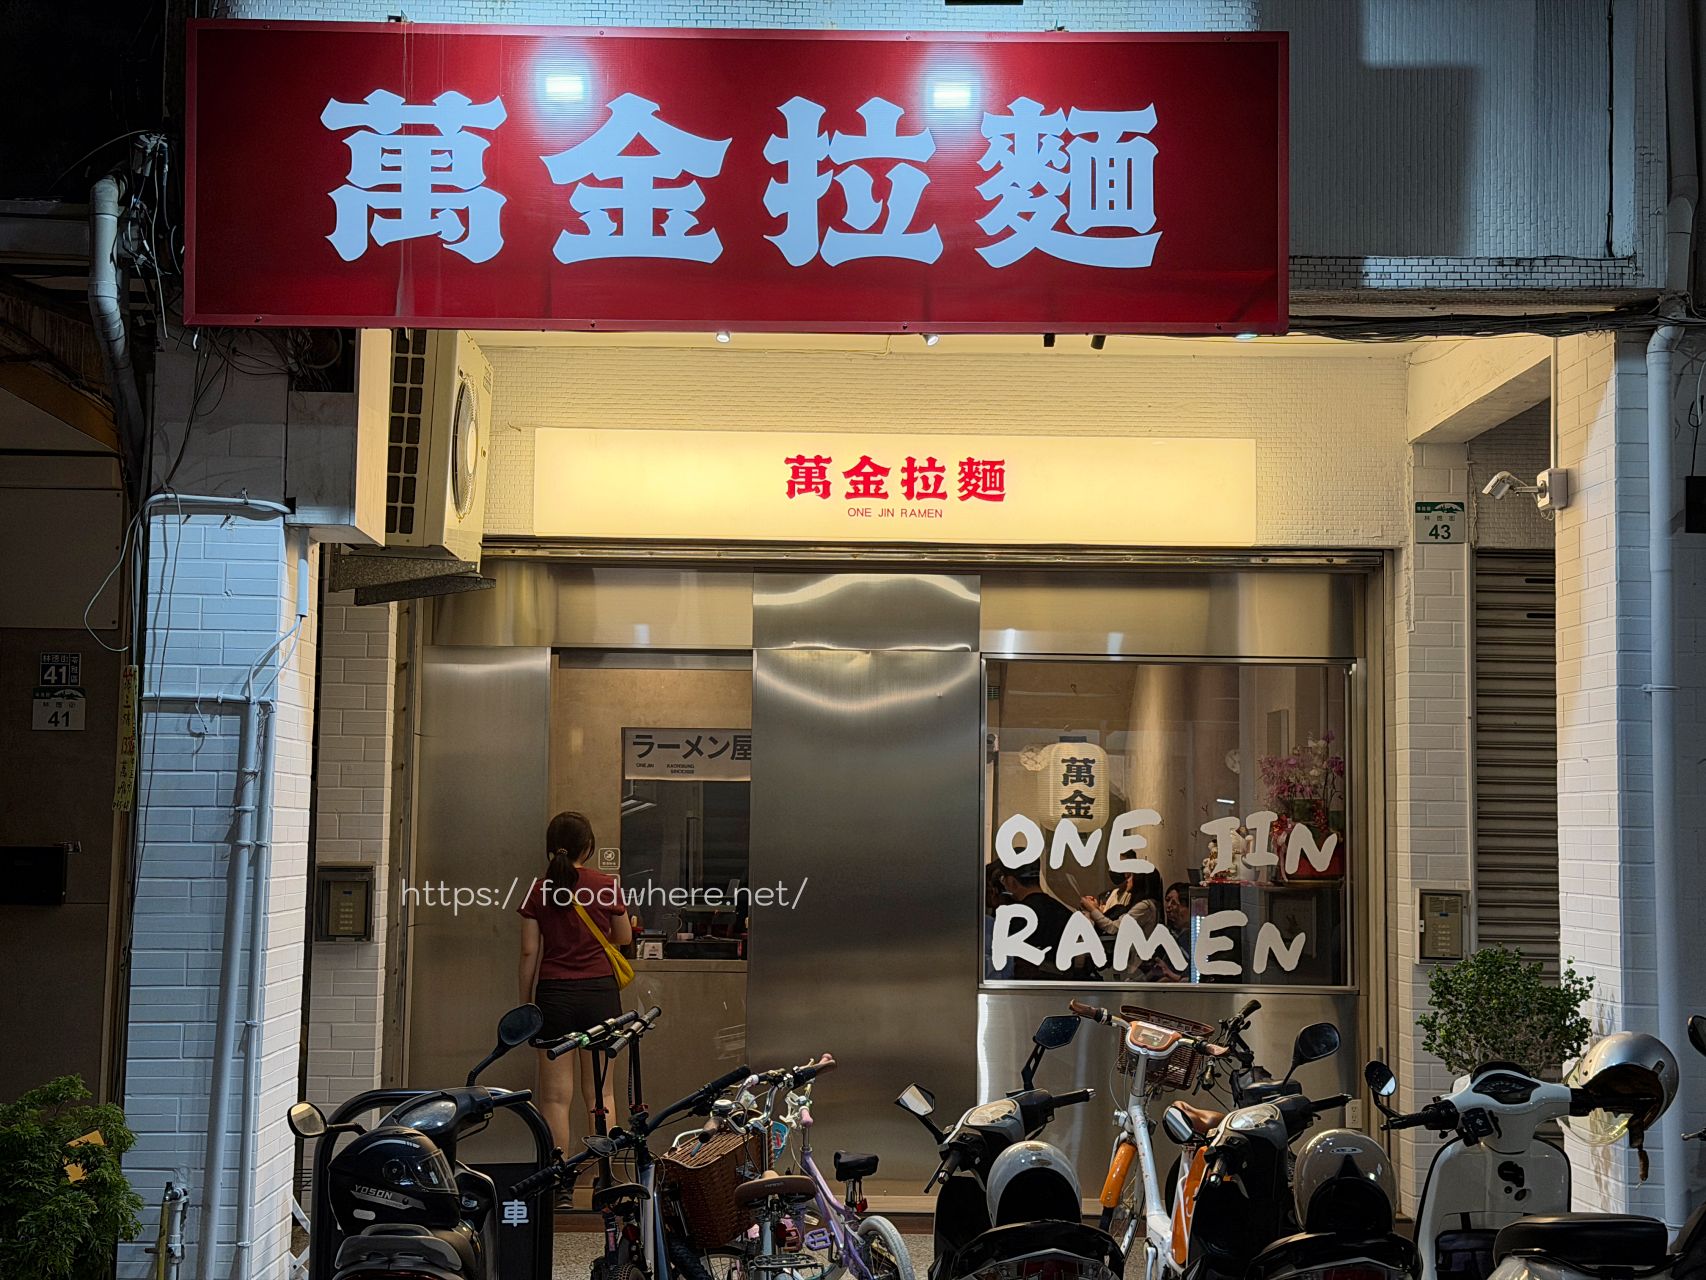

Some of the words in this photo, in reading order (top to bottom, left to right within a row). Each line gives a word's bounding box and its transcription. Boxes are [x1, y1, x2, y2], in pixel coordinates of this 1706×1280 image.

[320, 88, 1163, 269] 萬金拉麵
[784, 454, 1007, 502] 萬金拉麵
[847, 507, 872, 518] ONE
[878, 508, 895, 518] JIN
[900, 508, 943, 519] RAMEN
[1428, 524, 1451, 540] 43
[43, 665, 67, 684] 41
[47, 711, 70, 727] 41
[632, 734, 752, 761] ラーメン屋
[1060, 756, 1096, 820] 萬金
[995, 808, 1162, 874] ONE
[1200, 810, 1338, 876] JIN
[991, 903, 1306, 976] RAMEN
[354, 1184, 393, 1200] YOSON
[501, 1198, 530, 1228] 車
